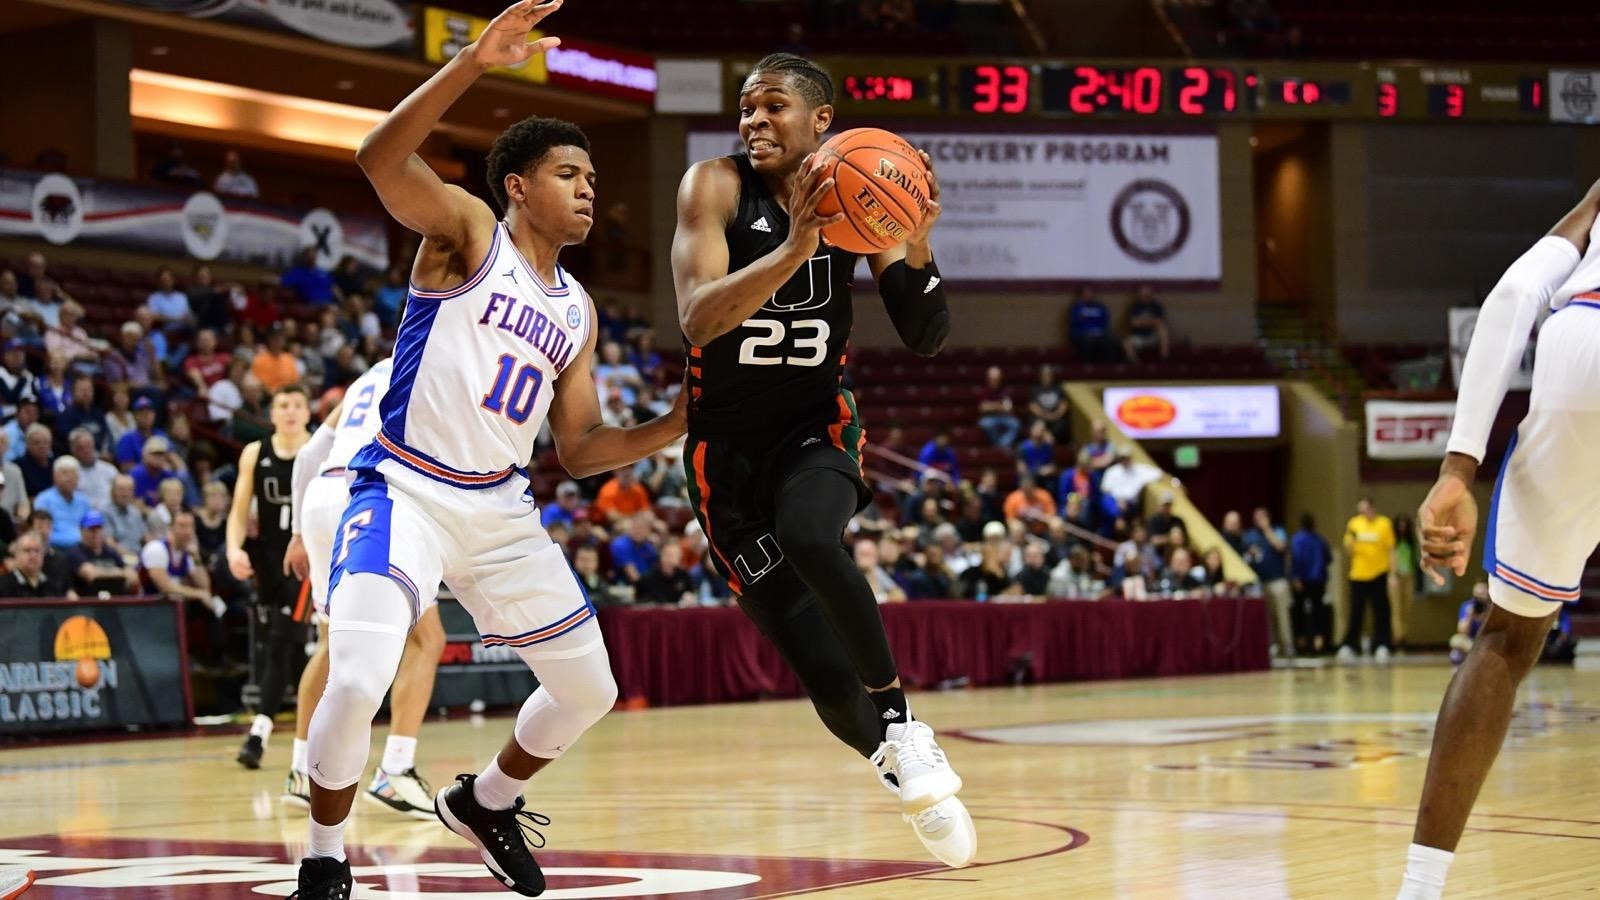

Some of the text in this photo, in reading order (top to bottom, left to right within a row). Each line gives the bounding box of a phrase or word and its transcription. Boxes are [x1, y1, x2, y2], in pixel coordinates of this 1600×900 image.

[972, 66, 1027, 113] 33
[1070, 67, 1160, 114] 2:40
[1179, 68, 1235, 114] 27
[1377, 83, 1397, 117] 3
[1447, 84, 1464, 117] 3
[1531, 81, 1542, 109] 1
[919, 141, 1037, 162] ECOVERY
[1044, 142, 1169, 163] PROGRAM
[873, 157, 929, 219] SPALDIN
[478, 292, 574, 375] FLORIDA
[738, 318, 831, 367] 23
[344, 383, 376, 427] 2
[480, 352, 544, 426] 10
[1375, 415, 1455, 444] ESP
[335, 509, 373, 566] F
[734, 532, 785, 585] U
